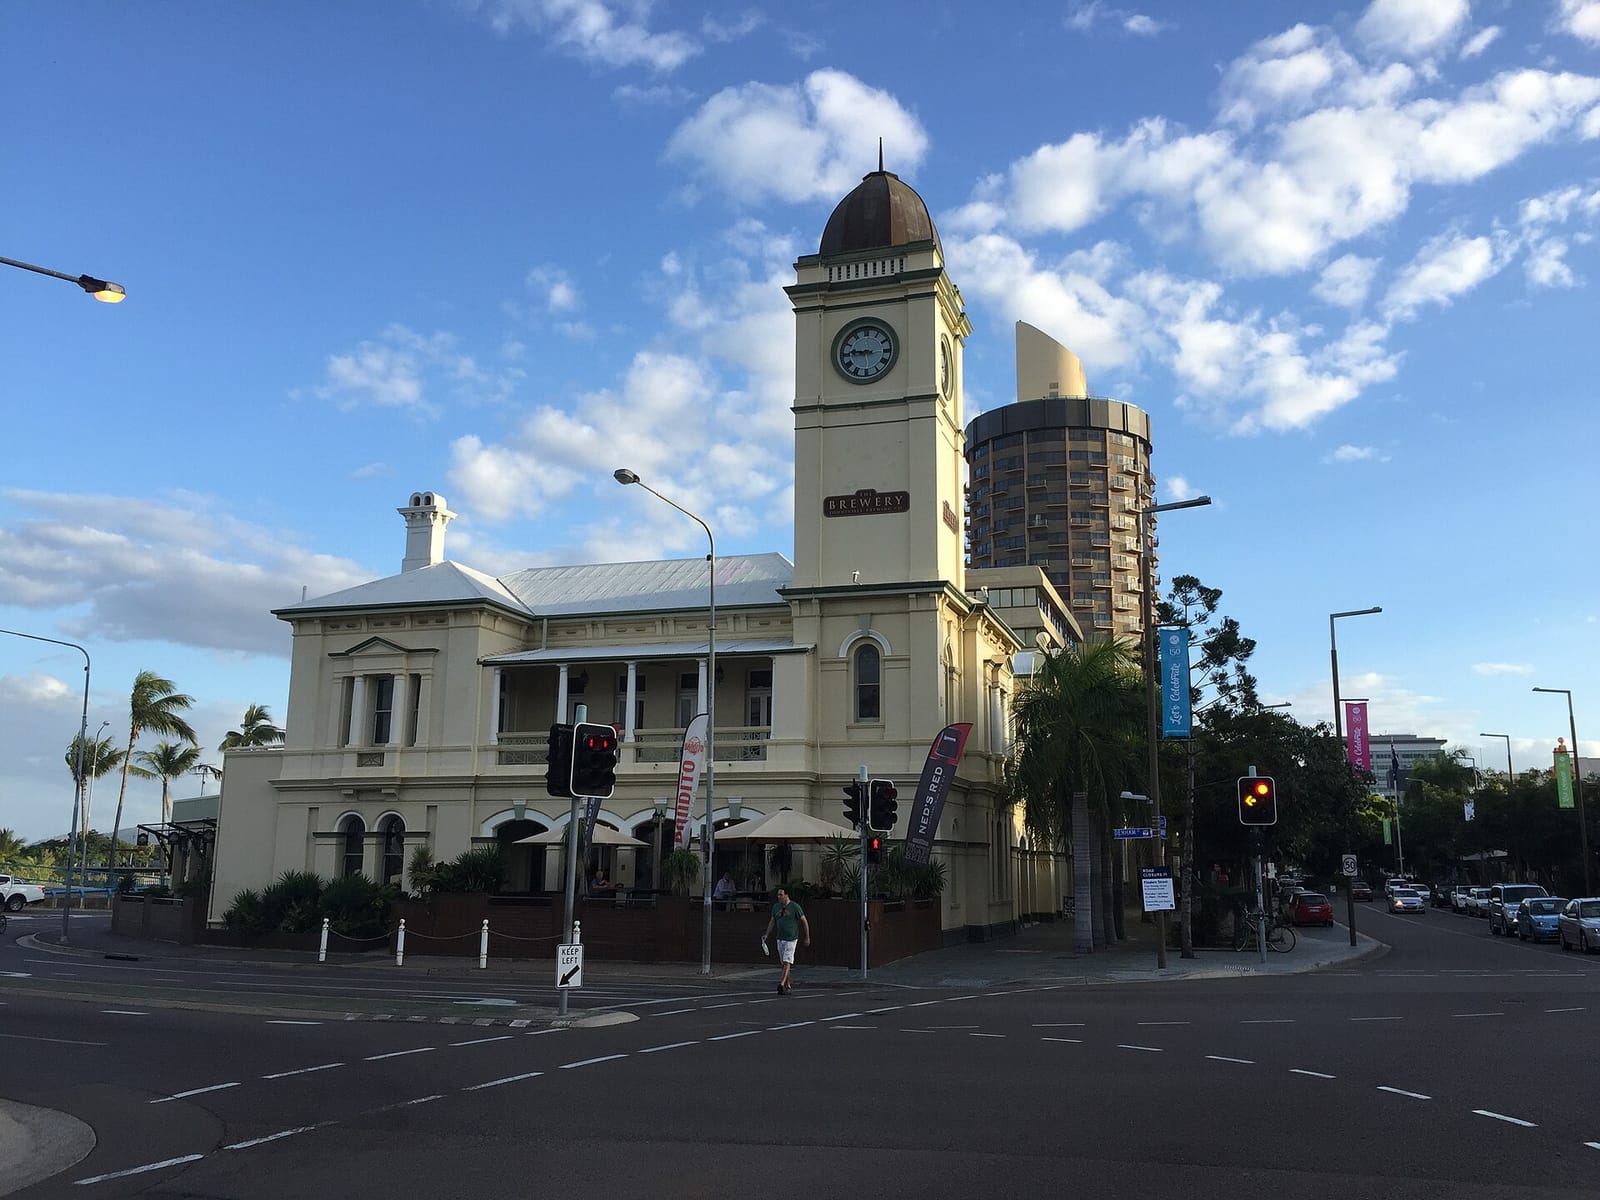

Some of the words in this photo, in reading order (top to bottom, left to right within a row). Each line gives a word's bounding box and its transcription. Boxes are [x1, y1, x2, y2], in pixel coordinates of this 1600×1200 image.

[829, 496, 903, 510] BREWERY
[1170, 664, 1180, 701] Celebrate
[1170, 706, 1182, 725] Let's
[918, 795, 934, 835] NED'S
[929, 766, 944, 793] RED
[1345, 861, 1356, 870] 50
